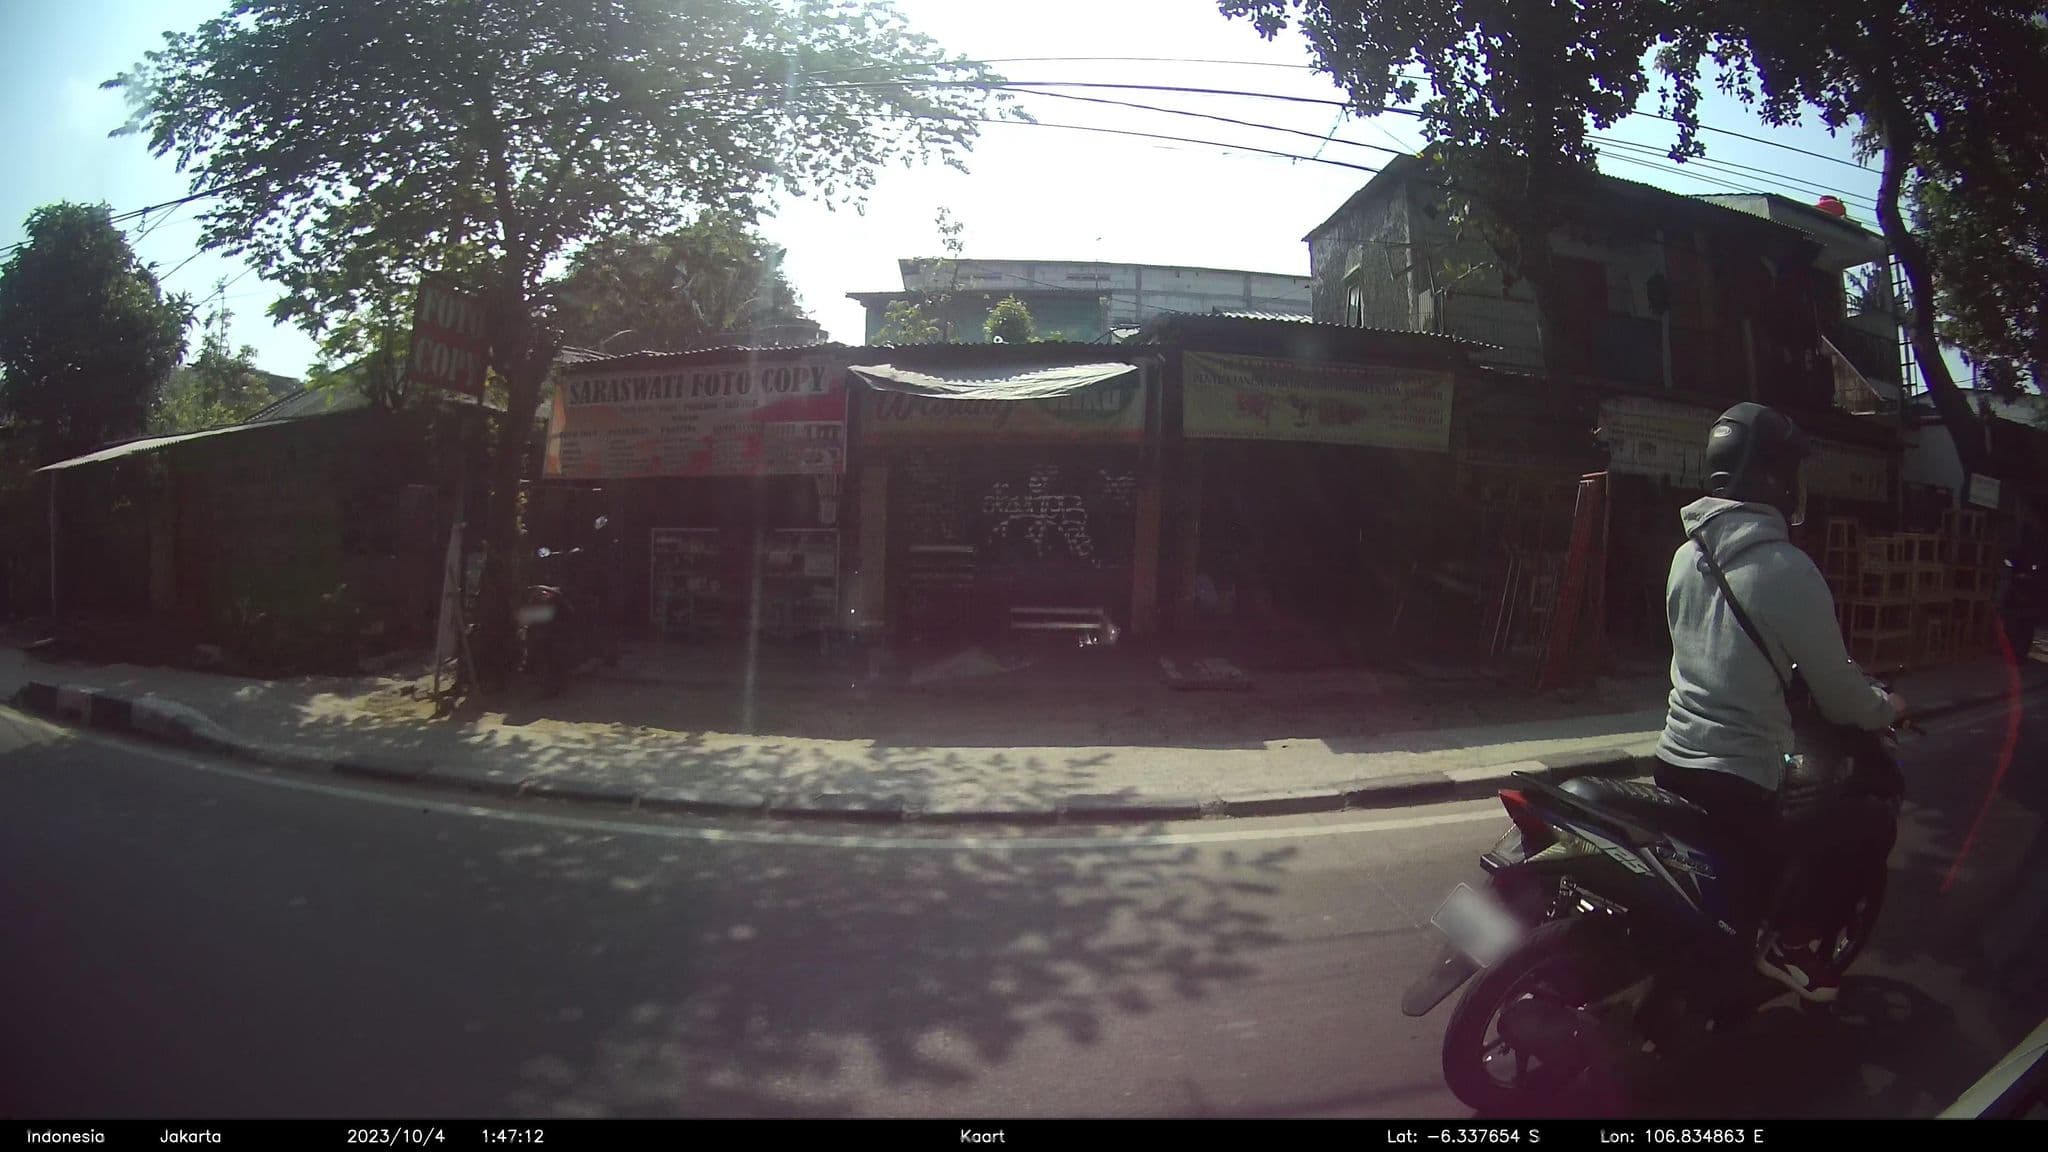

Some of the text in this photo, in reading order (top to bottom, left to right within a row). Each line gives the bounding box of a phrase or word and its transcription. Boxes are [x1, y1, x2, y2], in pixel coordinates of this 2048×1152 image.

[415, 337, 475, 386] COPY
[569, 367, 827, 405] SARASWATI FOTO COPY
[1603, 844, 1651, 875] 125
